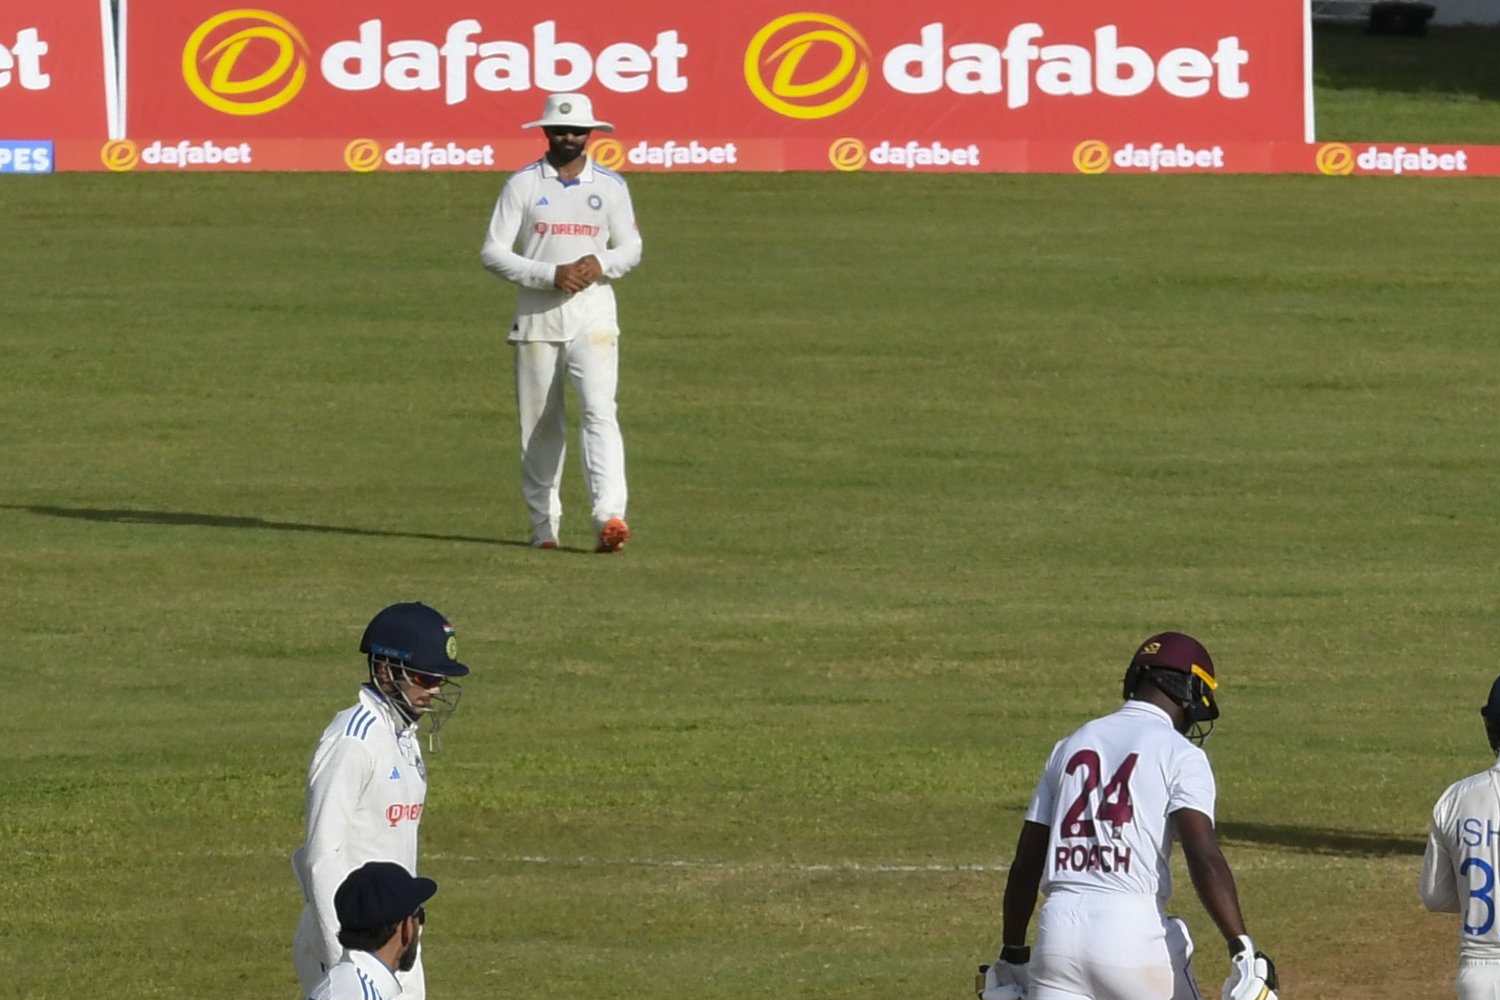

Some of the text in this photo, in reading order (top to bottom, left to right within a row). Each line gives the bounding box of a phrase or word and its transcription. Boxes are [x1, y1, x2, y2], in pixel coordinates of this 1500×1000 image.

[321, 19, 688, 105] dafabet
[883, 23, 1249, 109] dafabet
[141, 140, 252, 168] dafabet
[384, 141, 495, 169] dafabet
[627, 140, 738, 169] dafabet
[869, 140, 980, 170] dafabet
[1113, 142, 1224, 171] dafabet
[1356, 145, 1467, 174] dafabet
[1061, 750, 1139, 839] 24
[1055, 845, 1132, 874] ROACH
